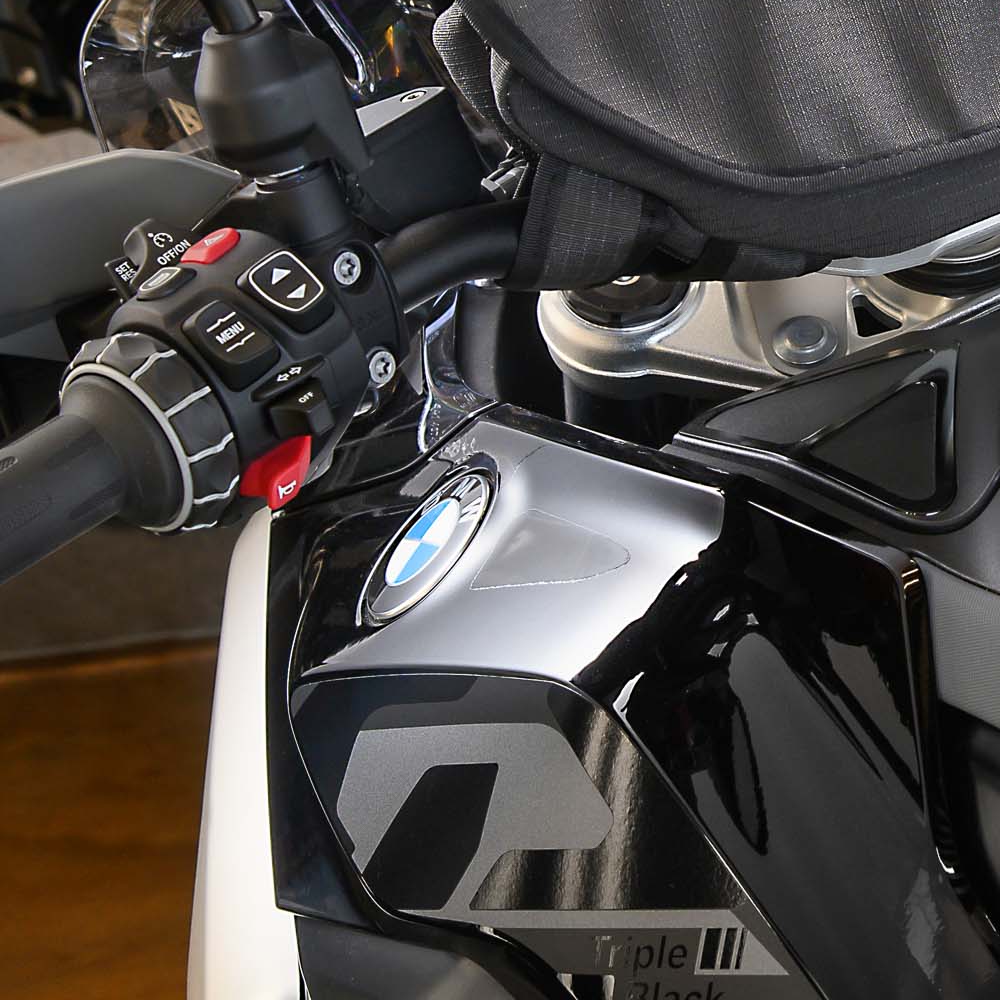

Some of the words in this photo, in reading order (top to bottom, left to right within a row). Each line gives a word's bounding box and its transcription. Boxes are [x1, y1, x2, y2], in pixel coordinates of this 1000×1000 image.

[156, 239, 192, 266] OFF/ON
[114, 261, 131, 275] SET
[215, 321, 245, 345] MENU
[593, 935, 688, 976] Triple
